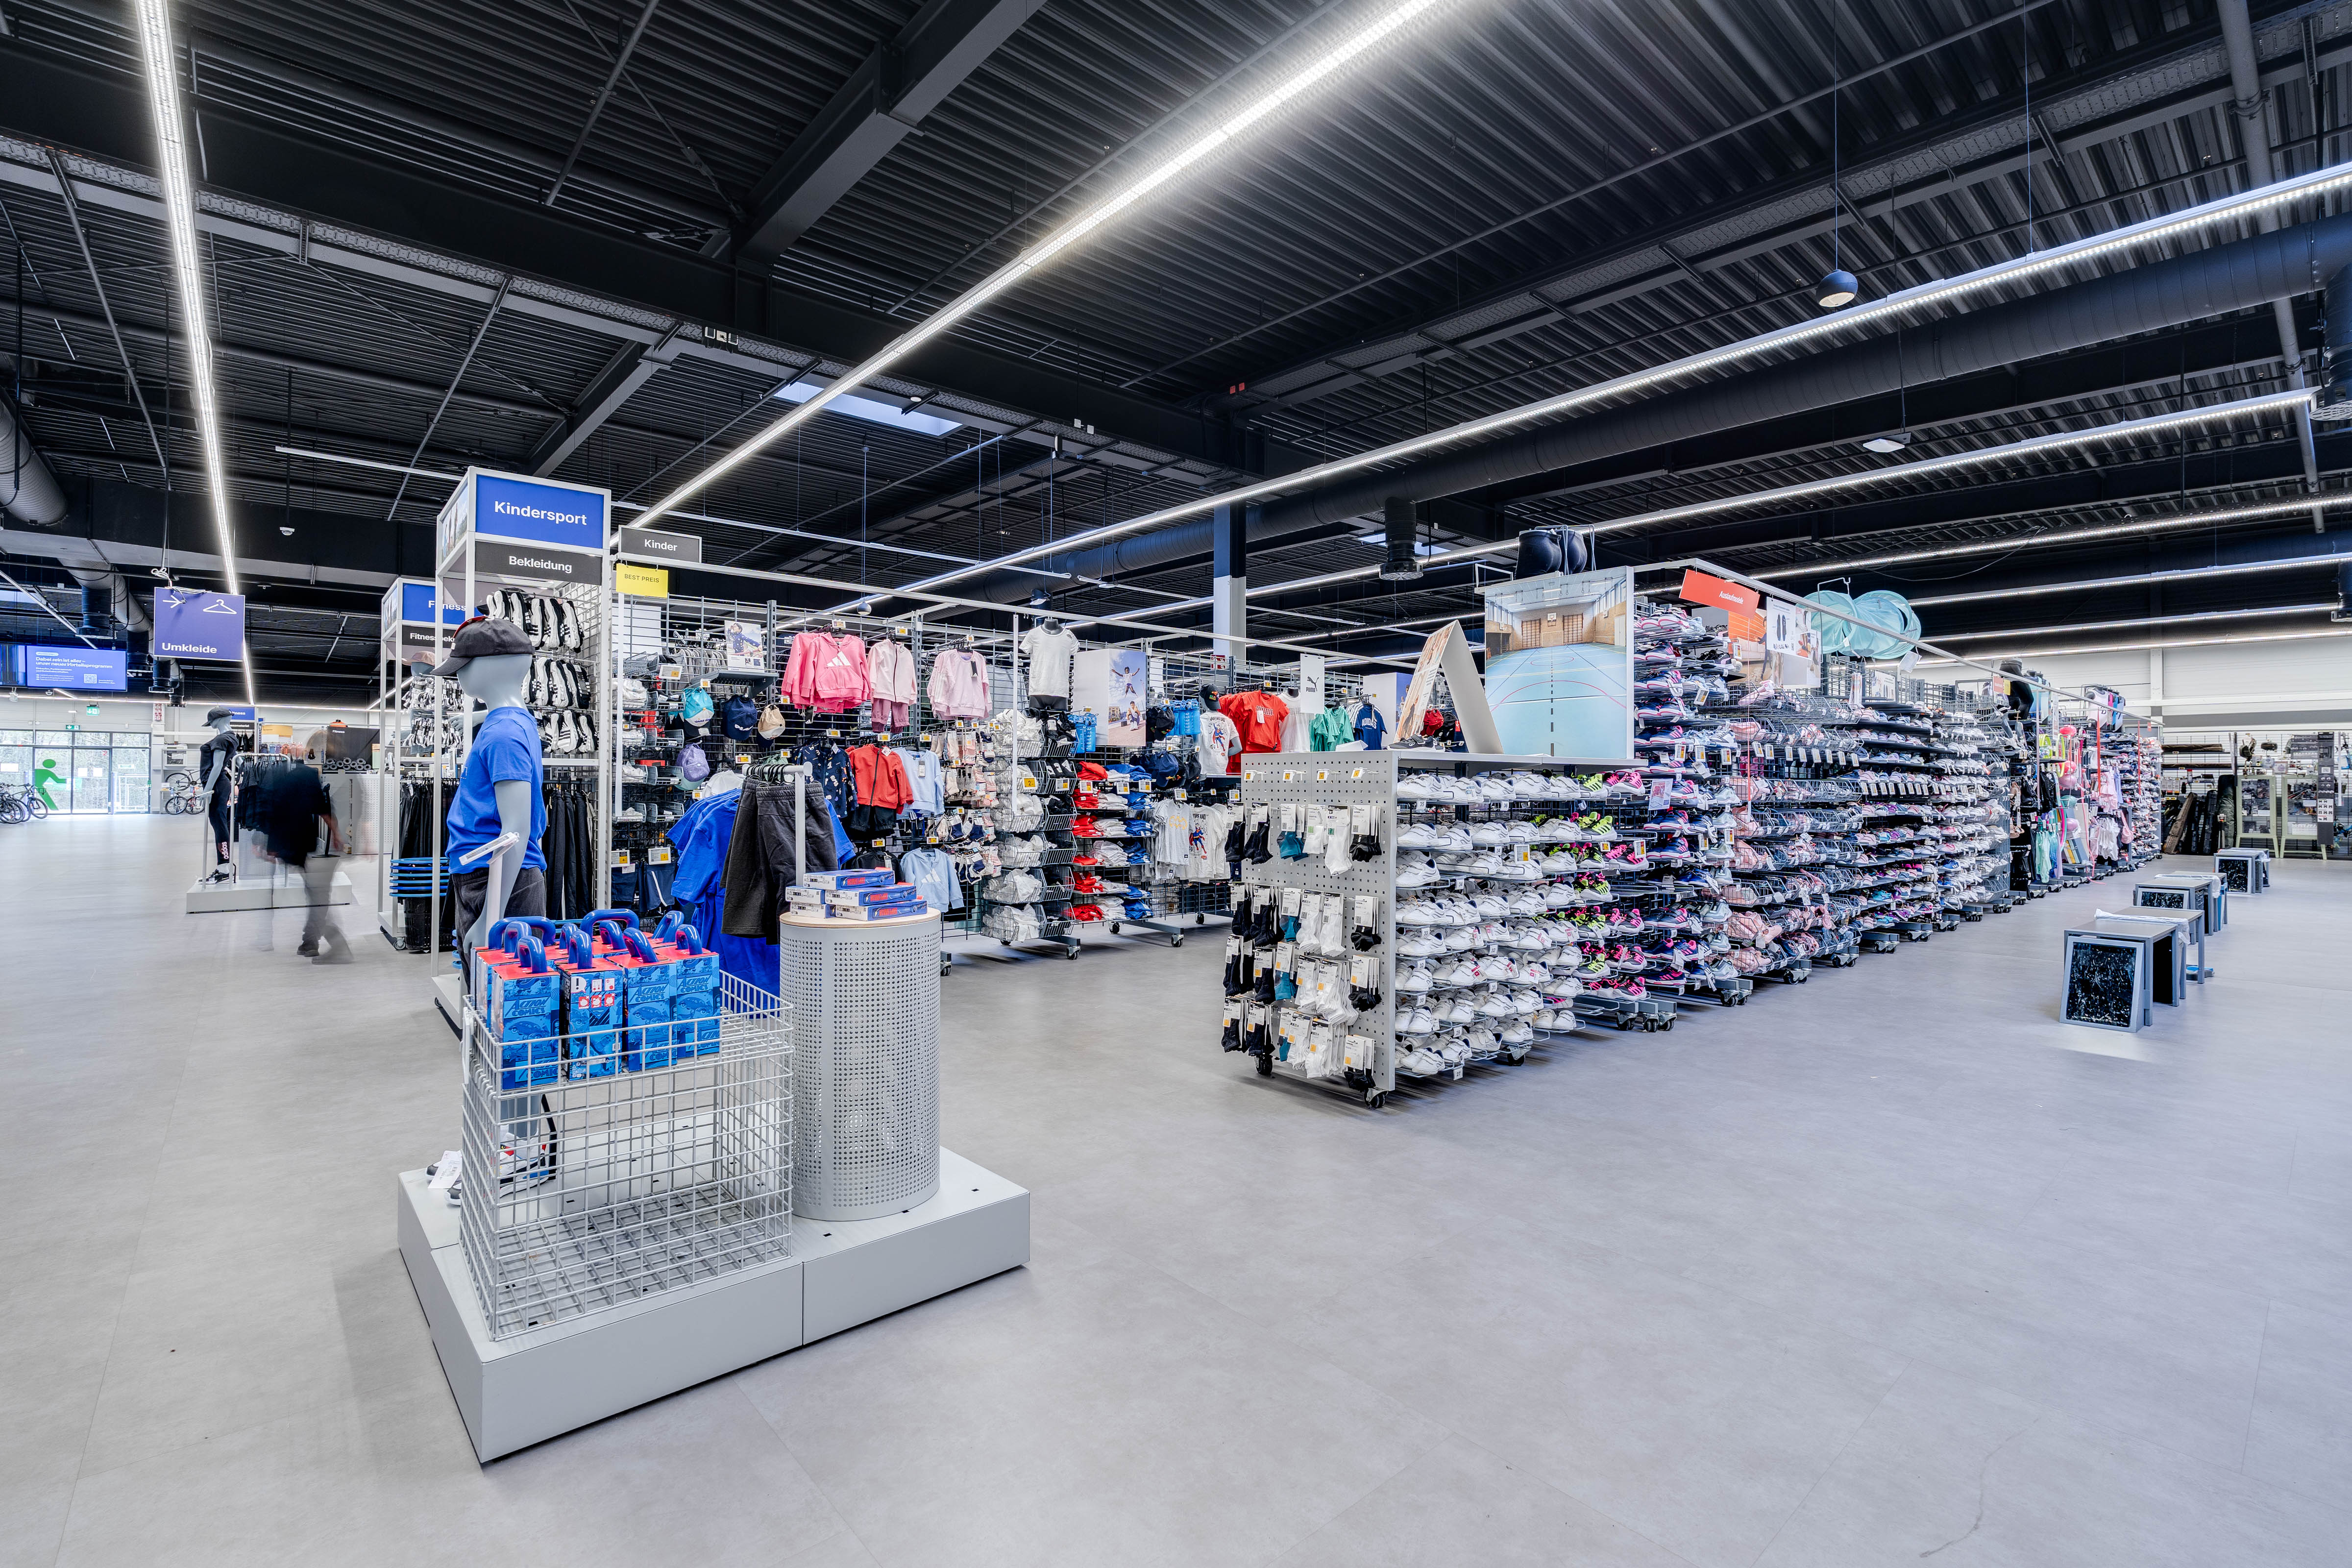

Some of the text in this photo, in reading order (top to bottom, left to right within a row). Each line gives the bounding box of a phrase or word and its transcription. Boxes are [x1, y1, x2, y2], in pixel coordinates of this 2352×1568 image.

[494, 501, 587, 525] Kindersport
[644, 539, 678, 551] Kinder
[509, 556, 572, 574] Bekleidung
[1719, 590, 1743, 604] Auslaufmodelle
[428, 600, 466, 611] Fness
[162, 642, 217, 654] Umkleide
[1362, 718, 1377, 729] ADIDAS
[221, 841, 229, 859] adidas
[677, 975, 710, 989] ACTION
[681, 984, 708, 993] COMICS
[631, 982, 669, 1000] ACTION
[636, 992, 664, 1002] COMICS
[506, 997, 550, 1014] ACTION
[512, 1007, 545, 1017] COMICS
